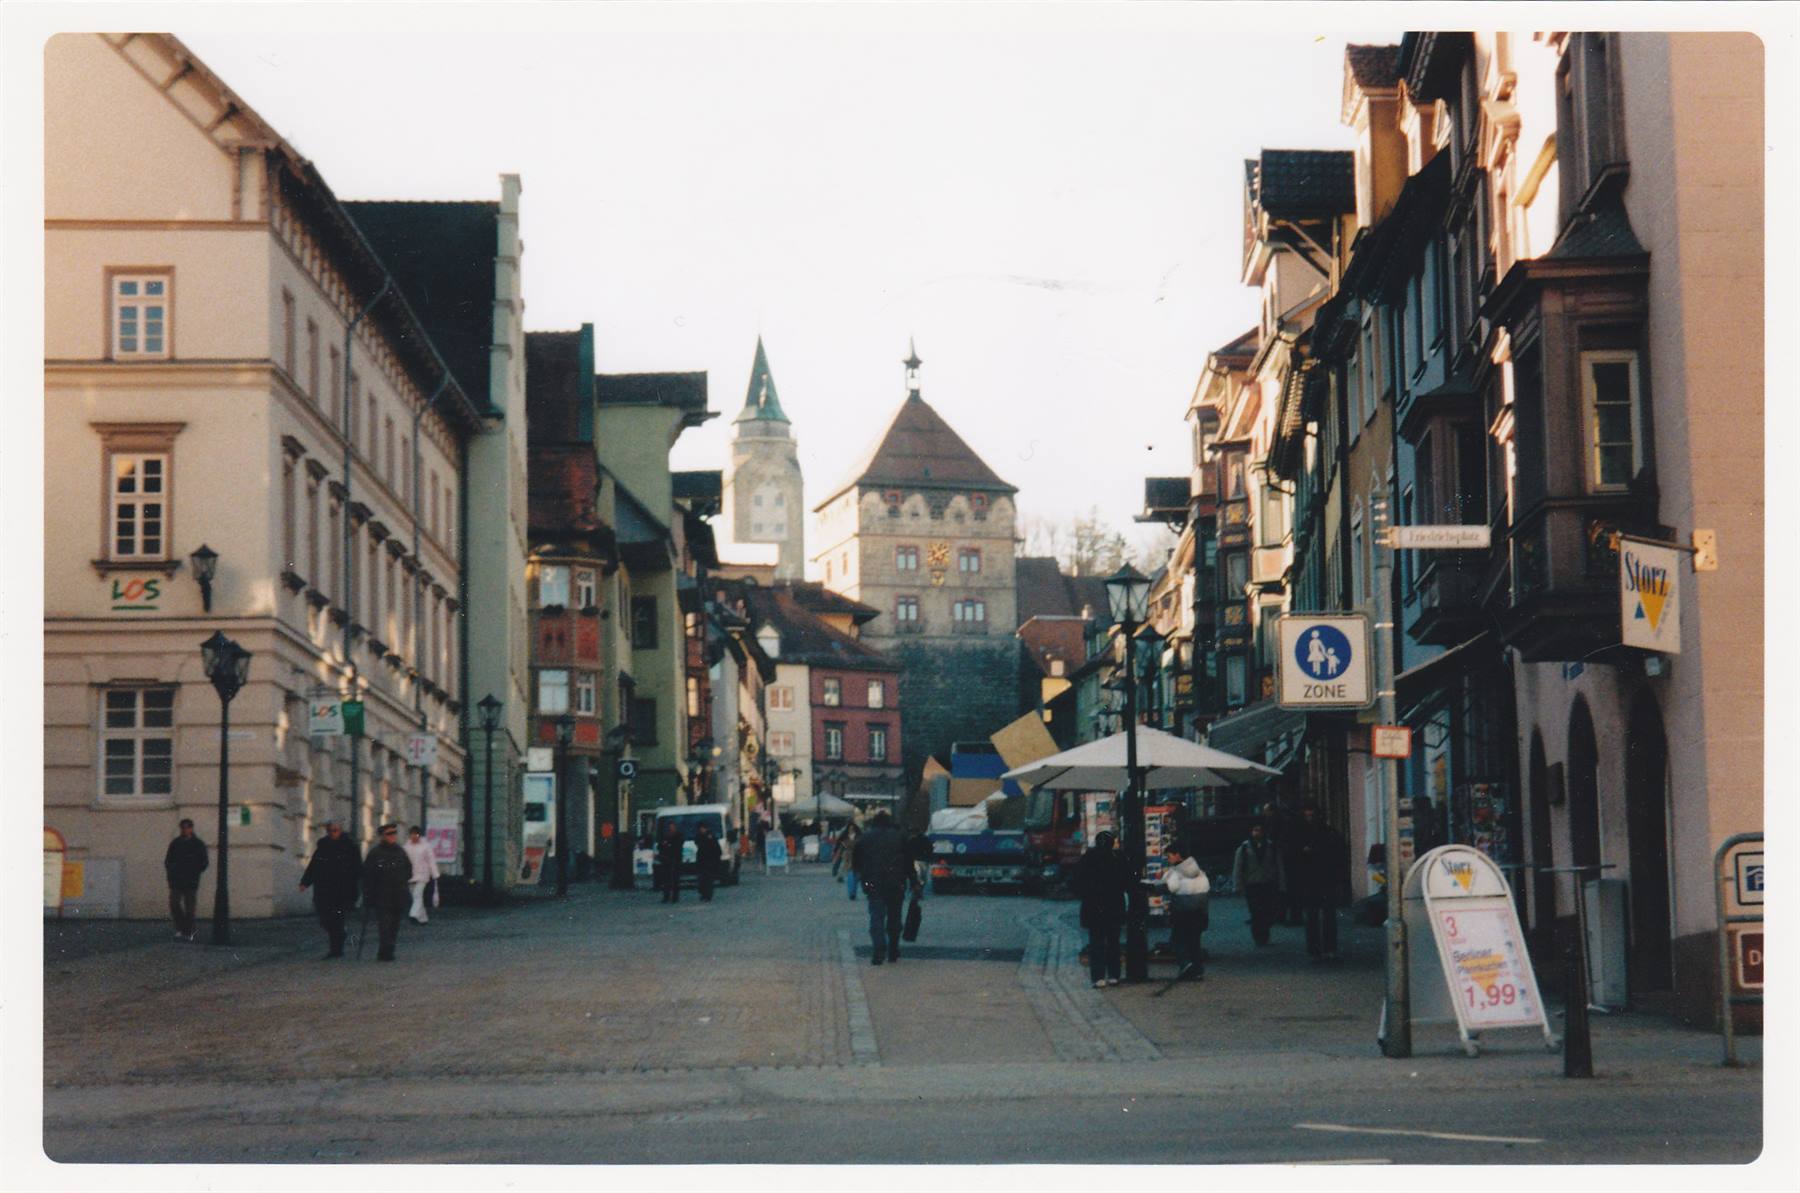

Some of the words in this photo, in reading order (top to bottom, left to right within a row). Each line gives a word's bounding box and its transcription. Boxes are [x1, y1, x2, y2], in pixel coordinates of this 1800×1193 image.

[112, 578, 160, 602] LOS
[1303, 684, 1347, 699] ZONE
[311, 705, 338, 720] LOS
[1445, 916, 1457, 938] 3
[1465, 984, 1515, 1009] 1,99
